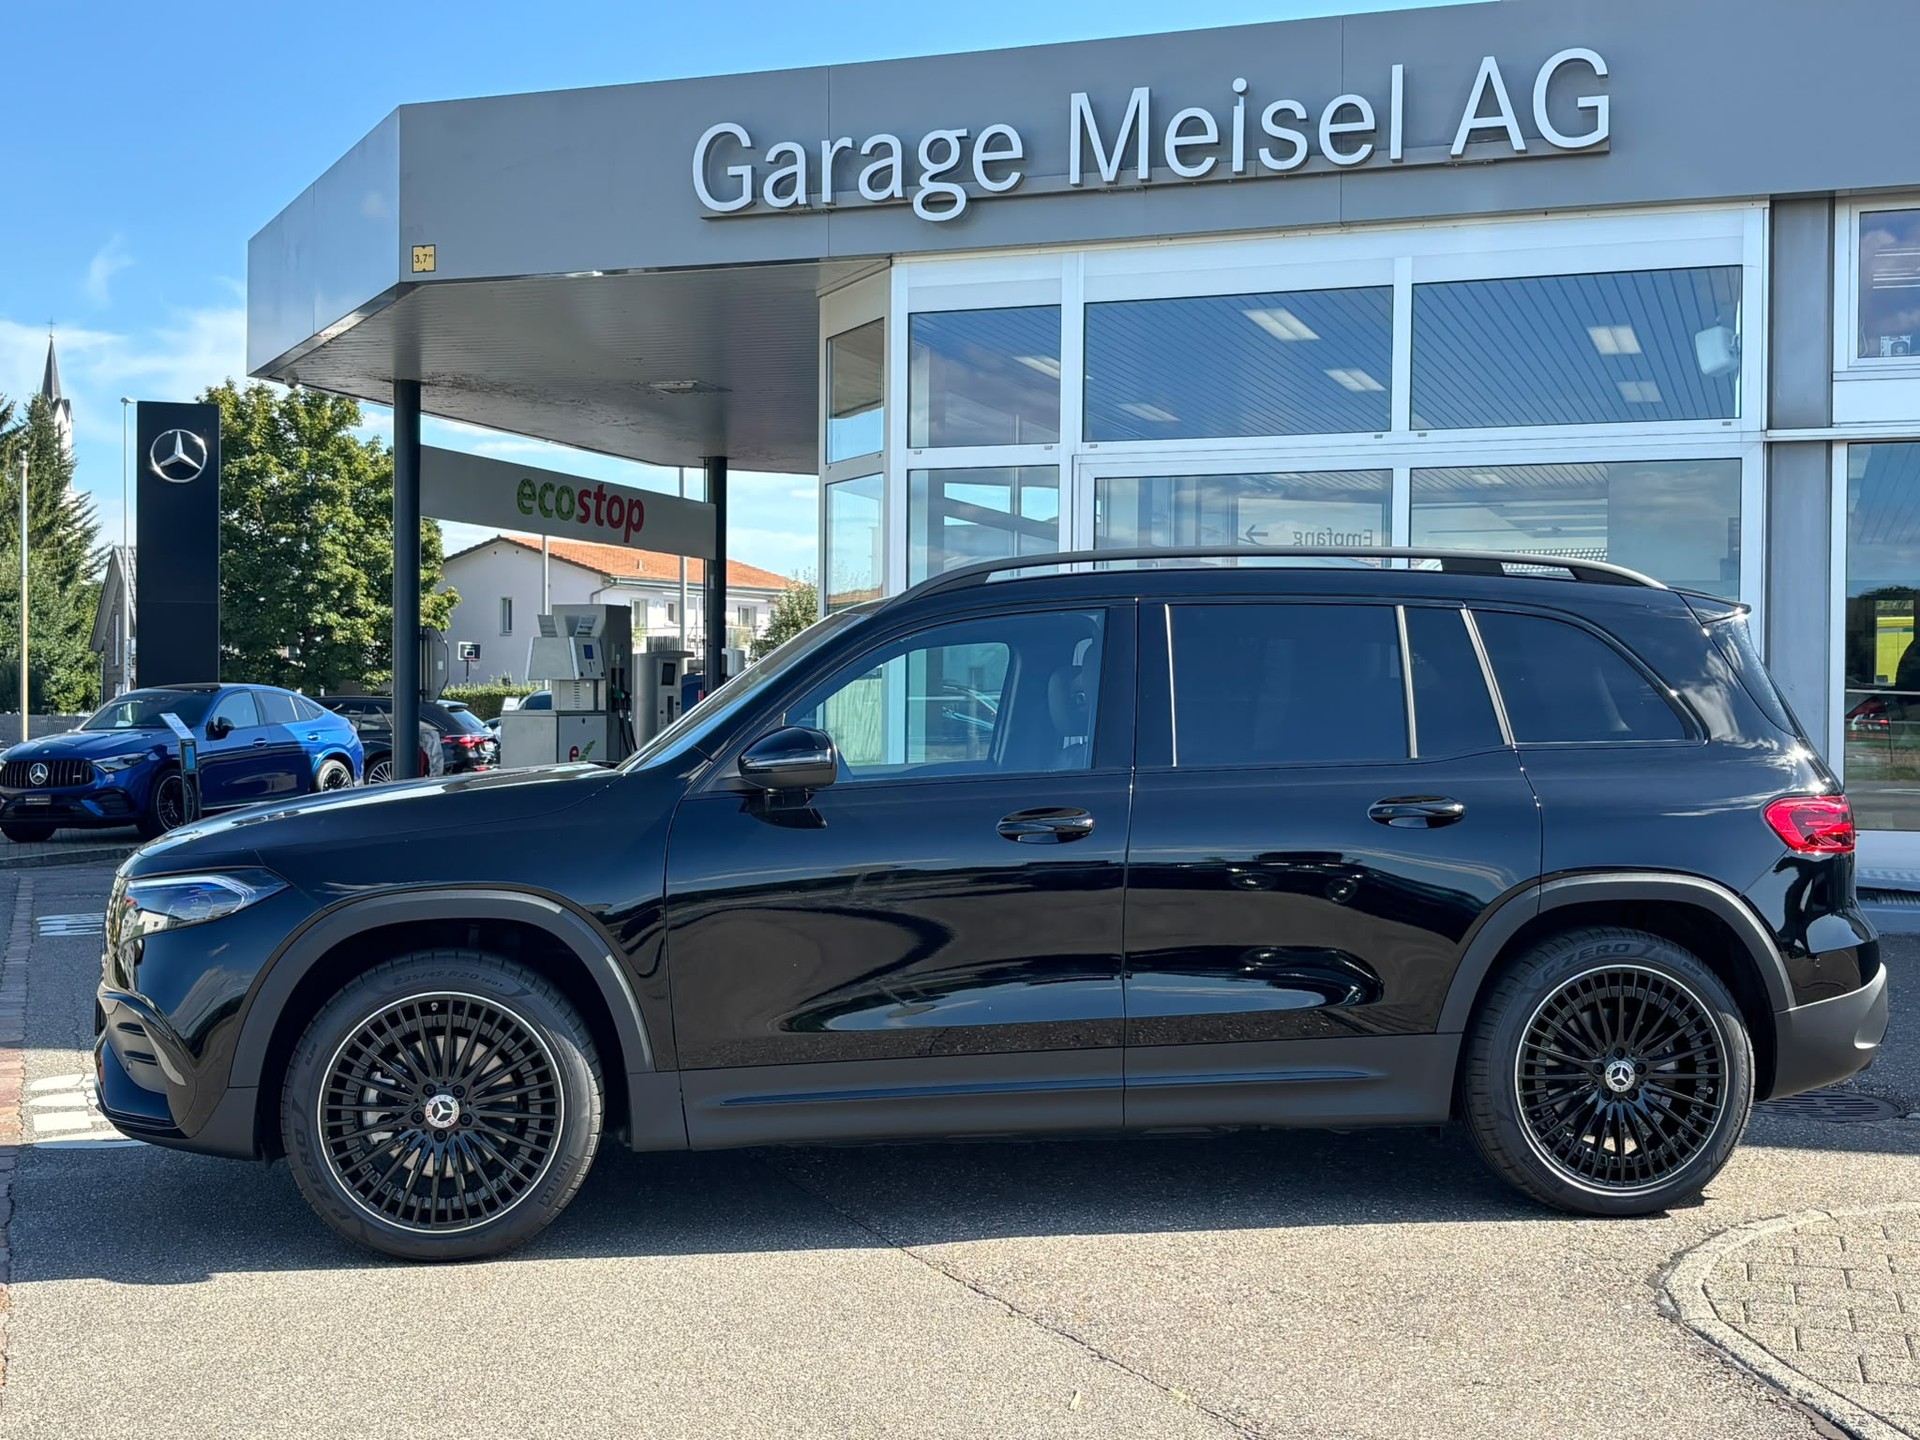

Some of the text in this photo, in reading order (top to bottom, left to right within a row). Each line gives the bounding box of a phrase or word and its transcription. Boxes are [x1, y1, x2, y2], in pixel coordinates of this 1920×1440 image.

[692, 47, 1610, 222] Garage Meisel AG
[516, 478, 645, 543] ecostop
